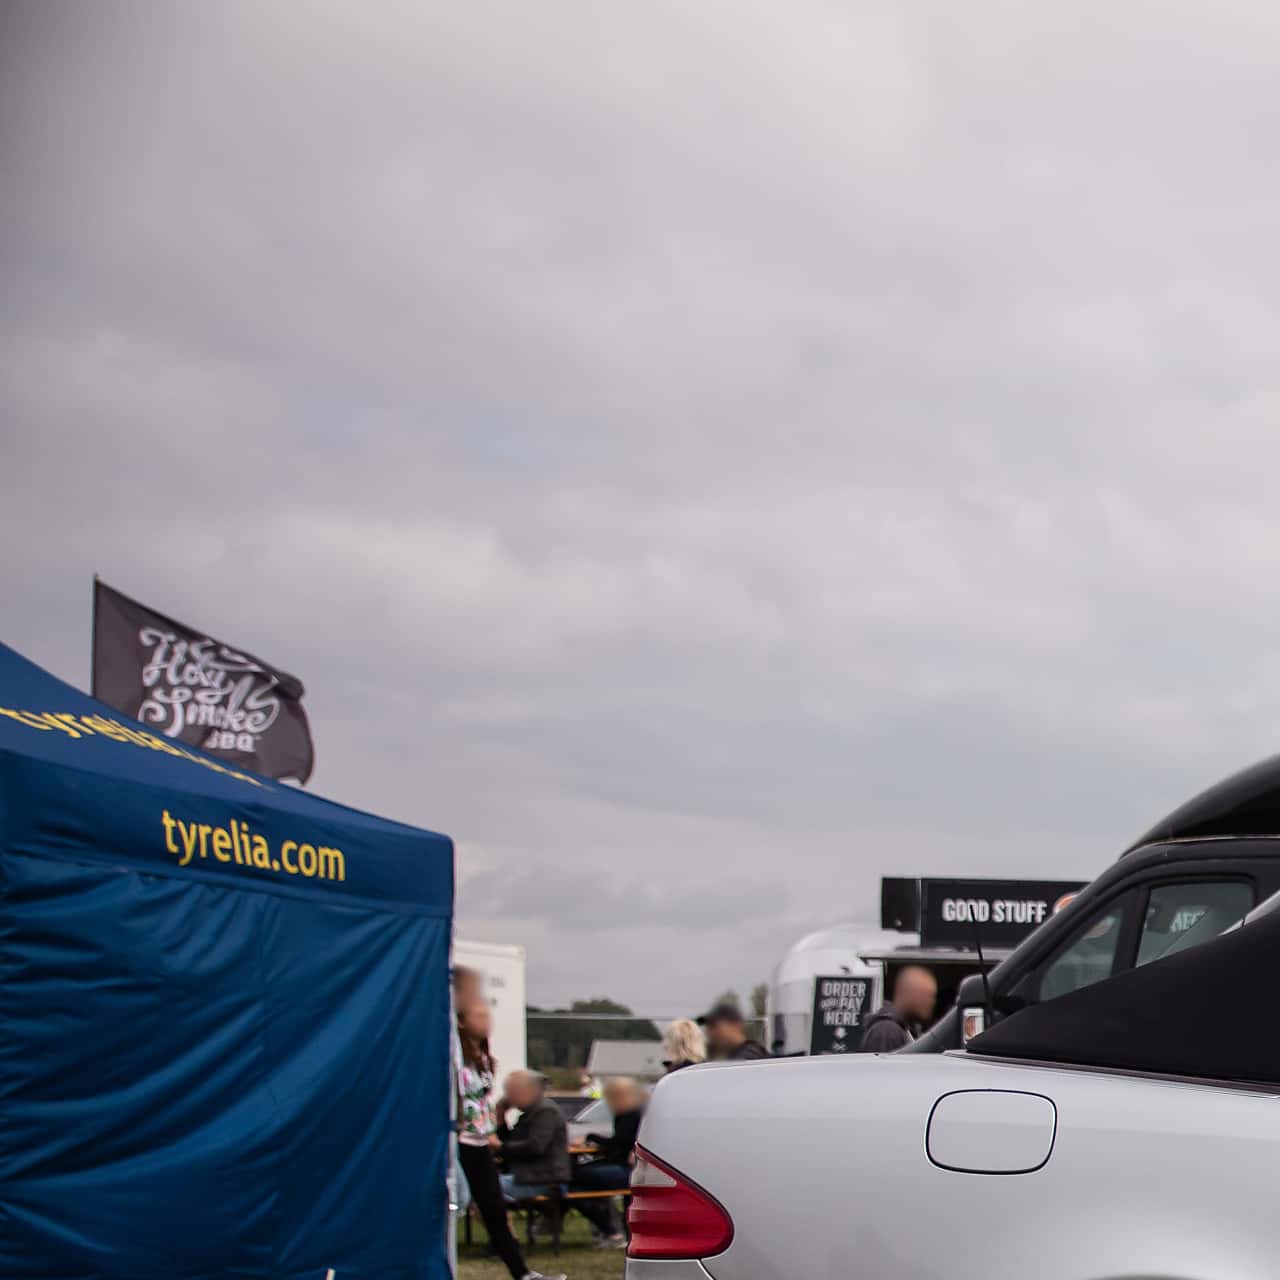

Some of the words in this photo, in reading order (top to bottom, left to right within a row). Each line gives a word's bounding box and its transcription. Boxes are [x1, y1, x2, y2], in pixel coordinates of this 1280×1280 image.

[161, 808, 347, 882] tyrelia.com
[992, 899, 1048, 924] STUFF
[821, 982, 867, 997] ORDER
[823, 1010, 861, 1026] HERE
